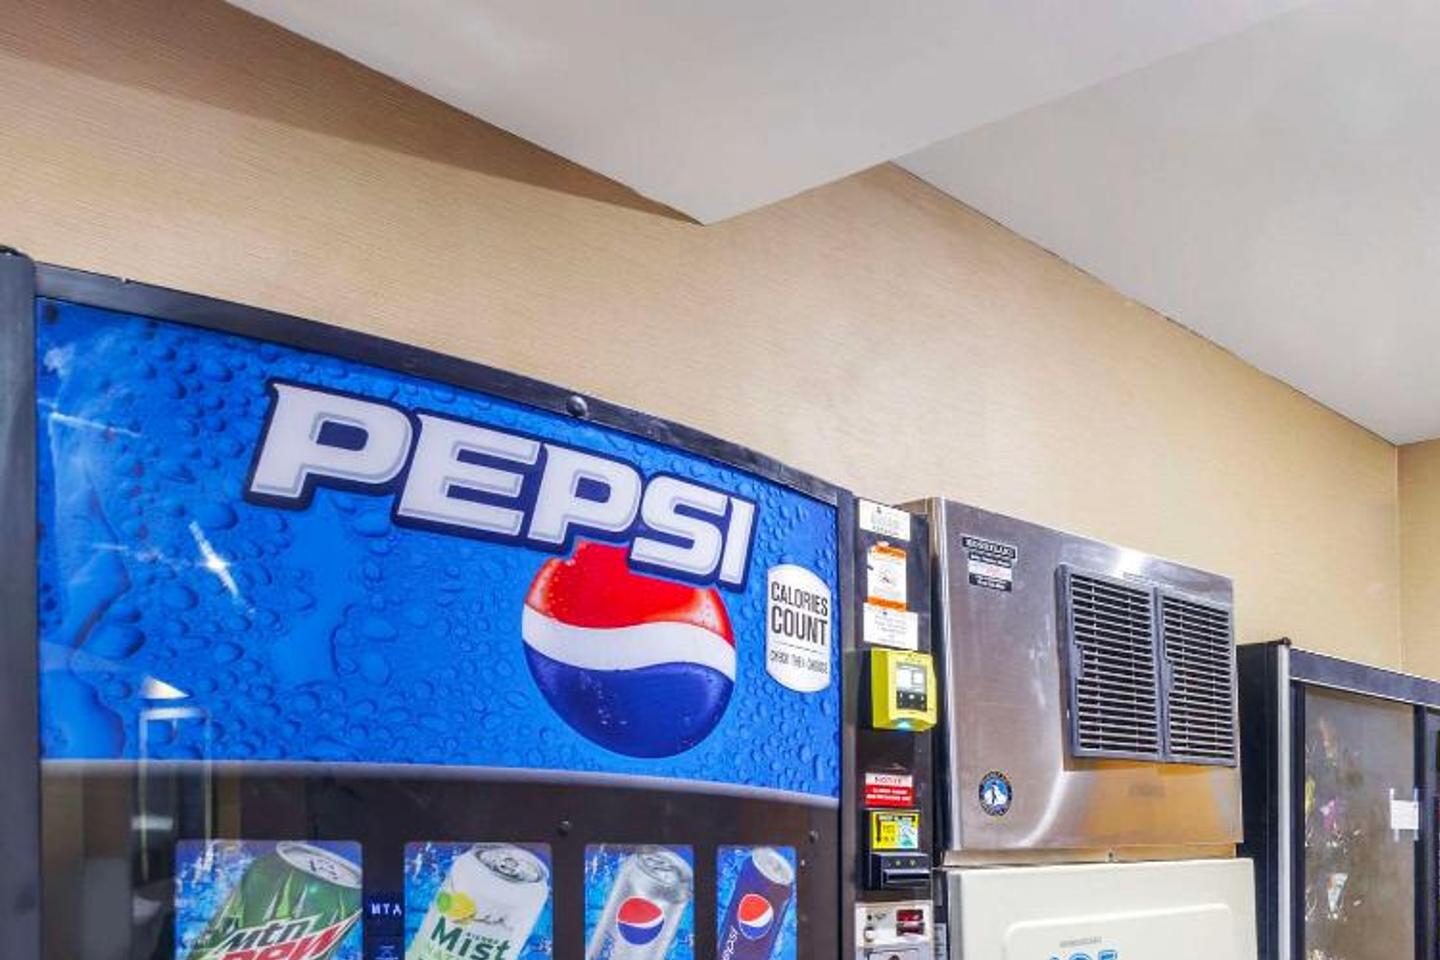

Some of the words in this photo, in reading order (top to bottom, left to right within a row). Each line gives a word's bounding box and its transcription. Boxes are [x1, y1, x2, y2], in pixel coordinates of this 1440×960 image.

[248, 379, 758, 587] PEPSI
[770, 581, 828, 617] CALORIES
[770, 605, 828, 646] COUNT
